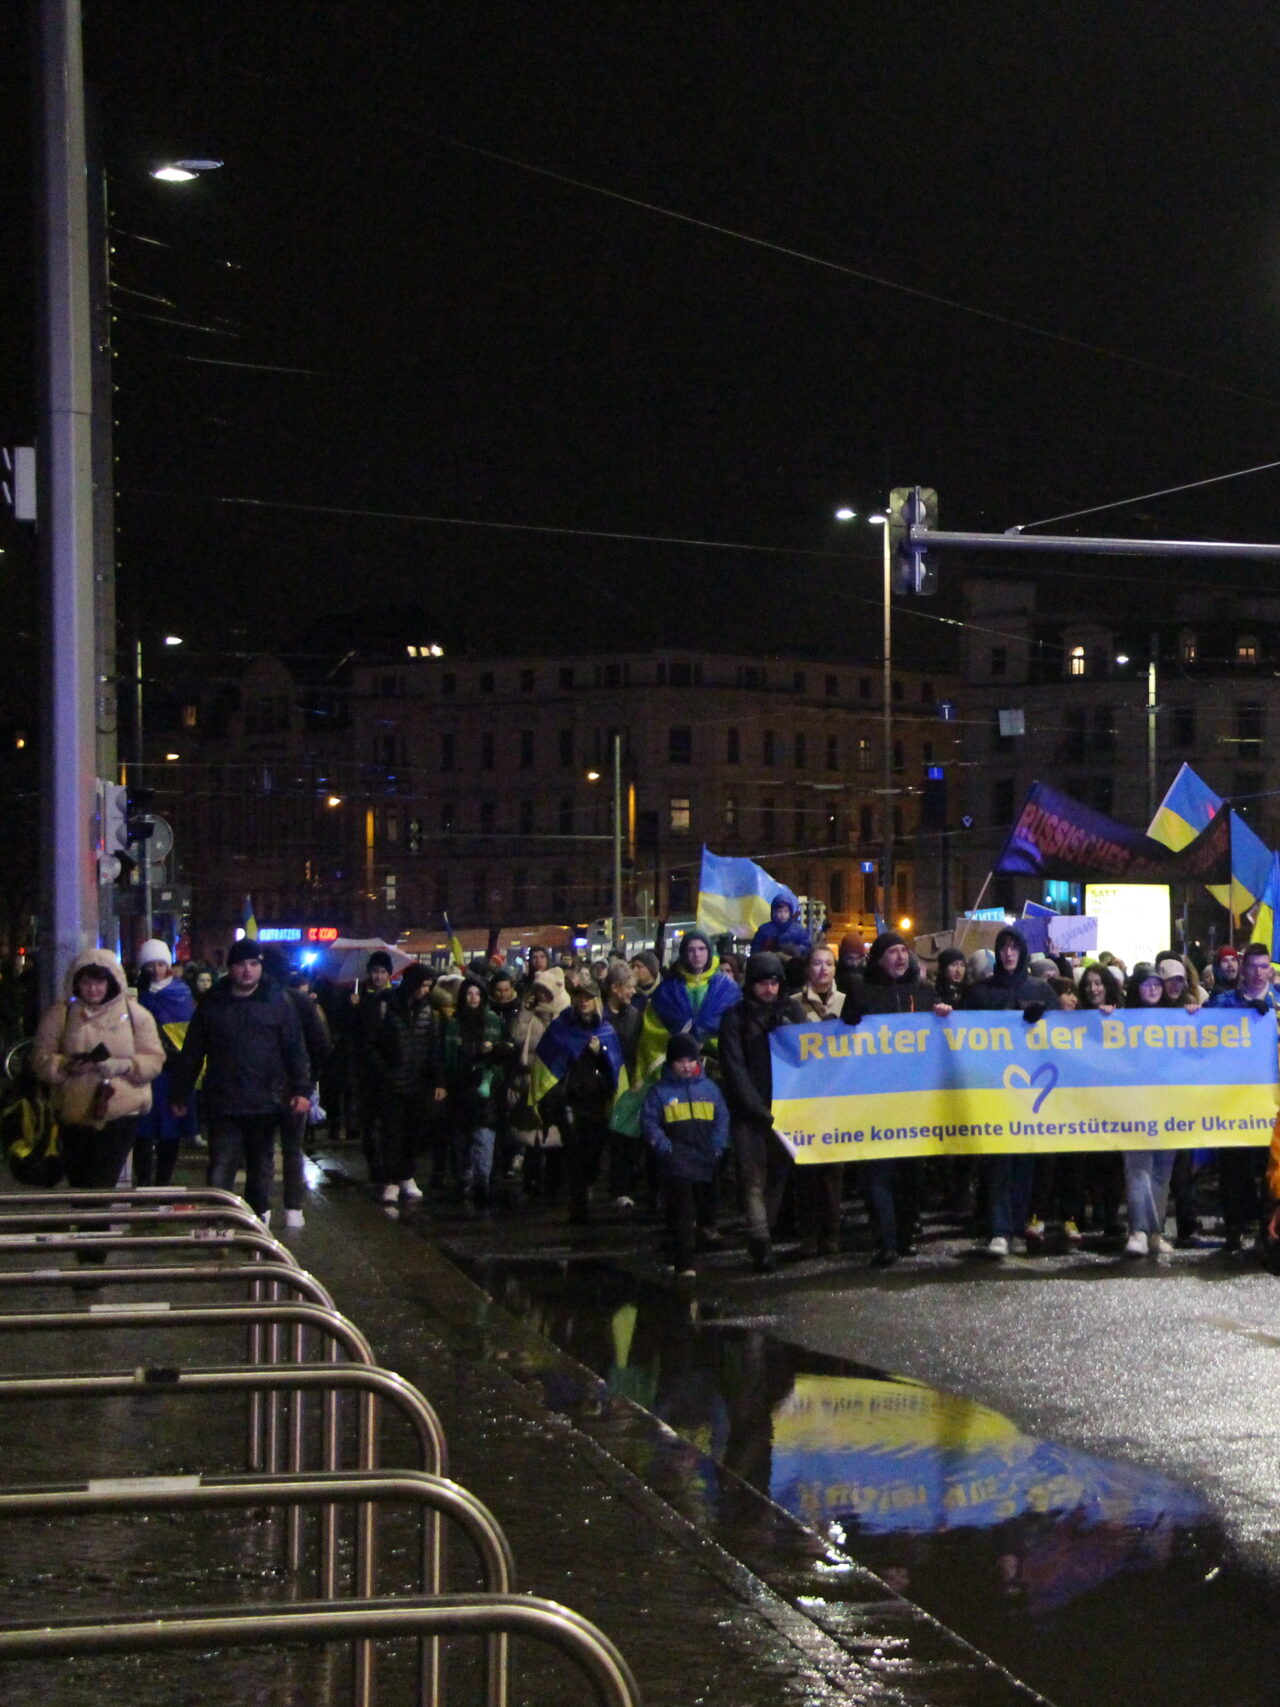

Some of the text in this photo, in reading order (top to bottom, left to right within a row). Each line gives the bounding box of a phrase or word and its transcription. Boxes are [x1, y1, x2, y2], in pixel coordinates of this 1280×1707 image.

[863, 862, 872, 872] T
[798, 1016, 1253, 1060] Runter von der Bremse!
[822, 1128, 865, 1145] eine
[870, 1119, 1004, 1142] konsequente
[1008, 1116, 1159, 1137] Unterstützung
[1164, 1114, 1196, 1132] der
[1201, 1114, 1278, 1131] Ukraine
